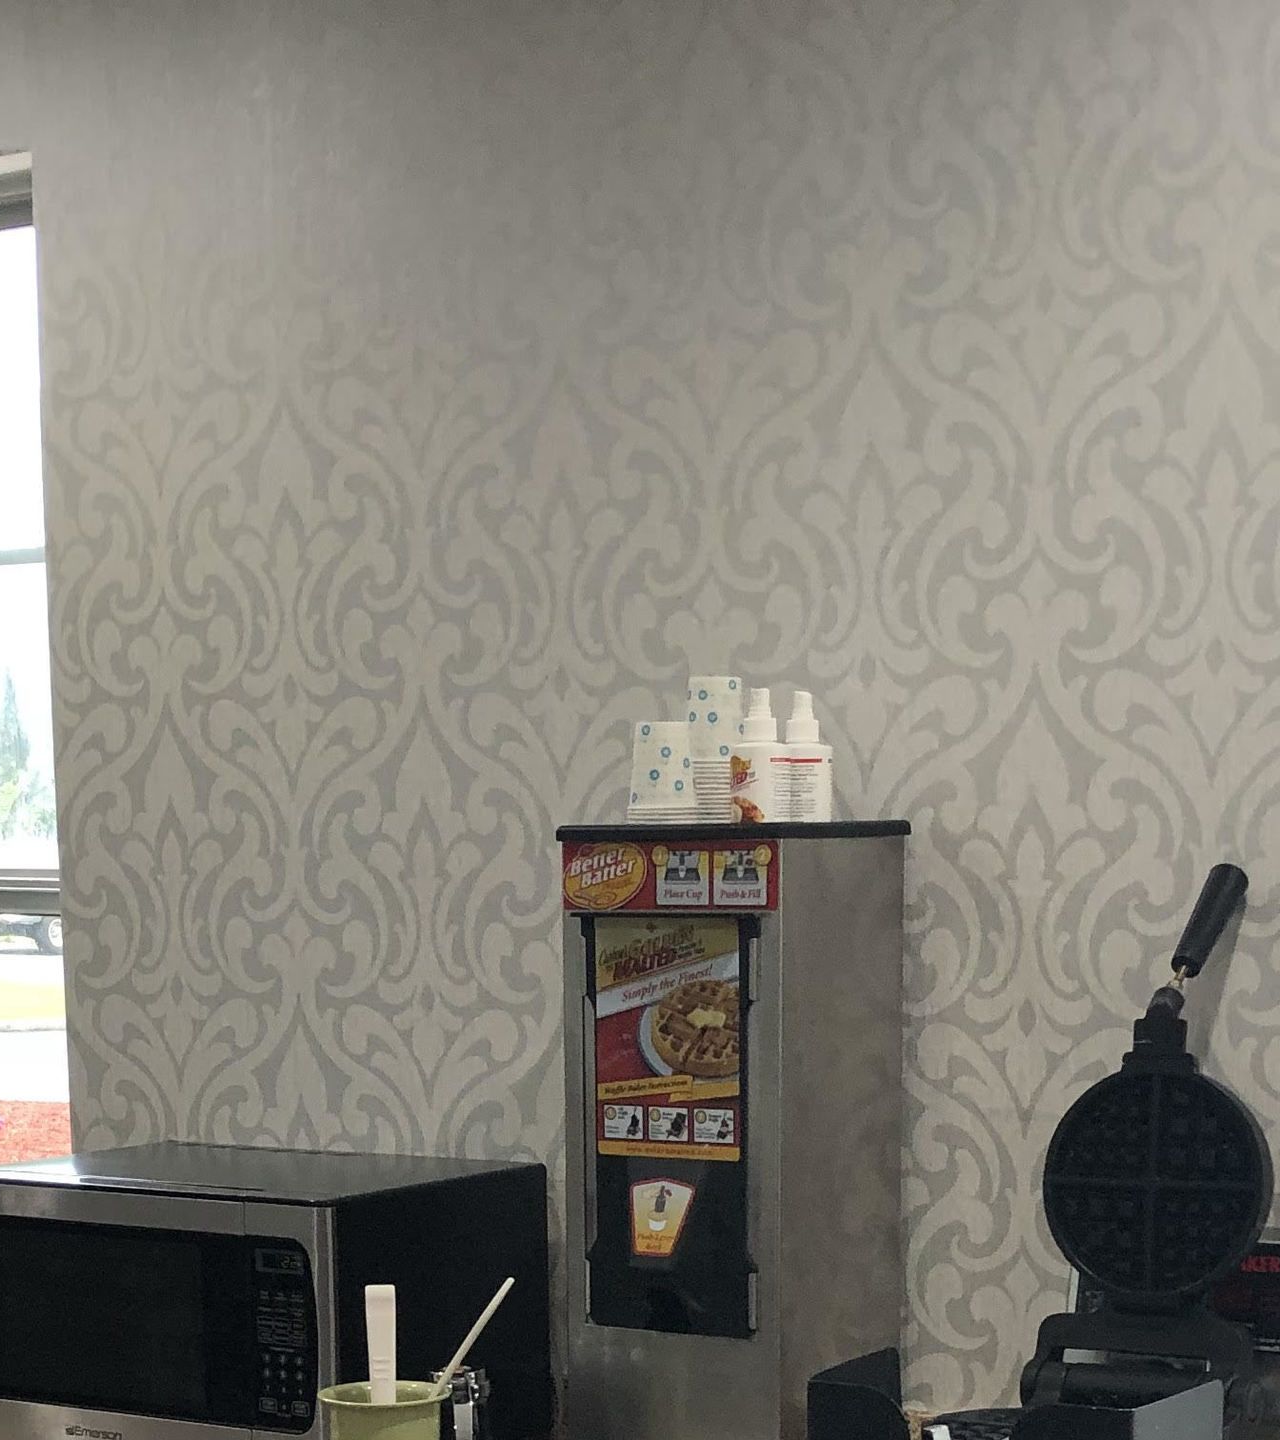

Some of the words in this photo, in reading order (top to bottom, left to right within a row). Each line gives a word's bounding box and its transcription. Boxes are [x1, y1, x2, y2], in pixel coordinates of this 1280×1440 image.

[570, 847, 625, 877] Better
[580, 859, 635, 888] Batter
[664, 889, 684, 898] Place
[686, 890, 703, 900] Cup
[720, 889, 738, 898] Push
[748, 889, 761, 898] Fill
[622, 981, 658, 1001] Simply
[659, 976, 677, 991] the
[678, 963, 713, 985] Finest!
